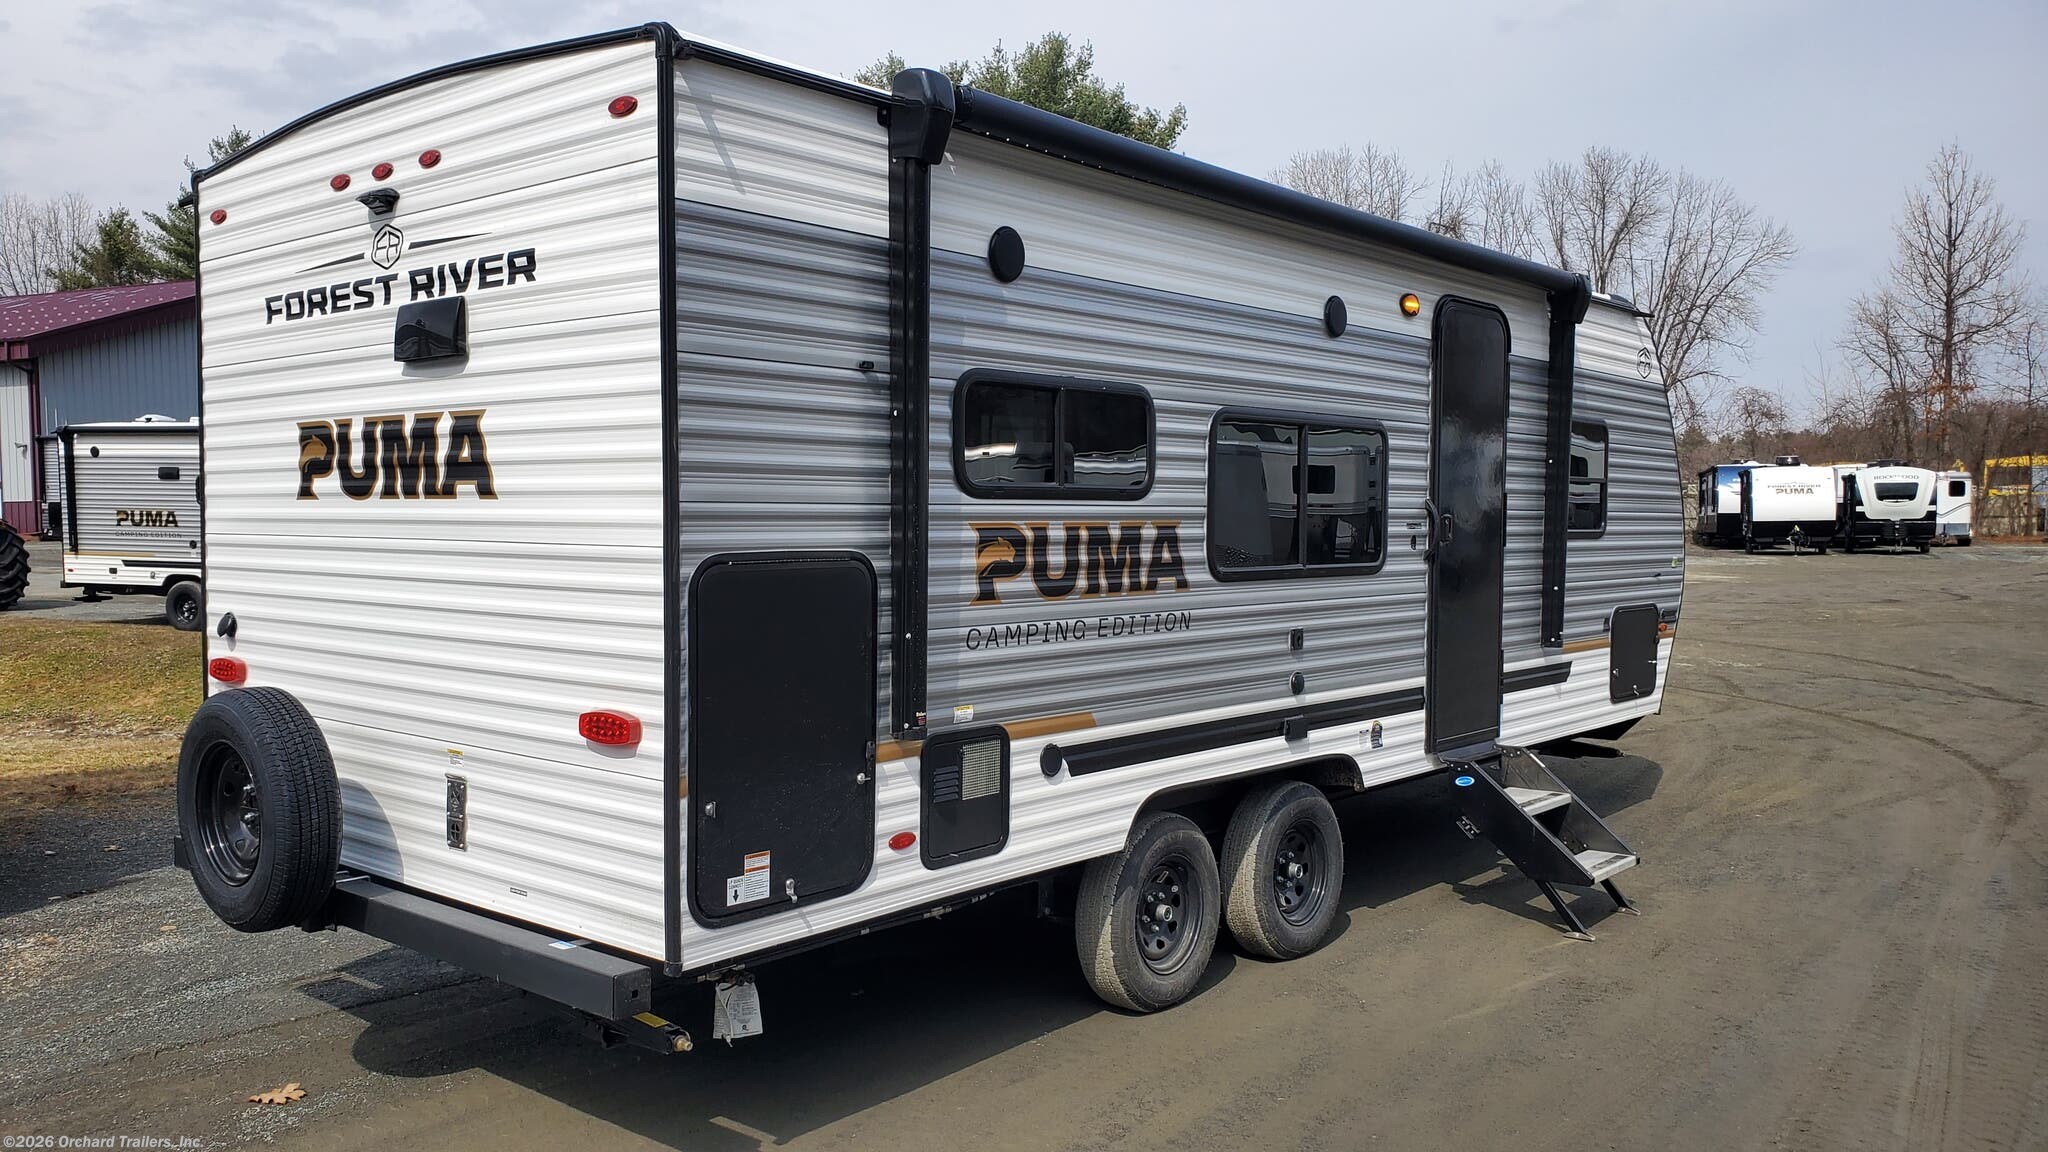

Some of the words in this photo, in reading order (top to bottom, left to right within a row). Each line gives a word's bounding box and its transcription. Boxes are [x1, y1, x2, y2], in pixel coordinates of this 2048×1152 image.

[264, 273, 399, 325] FOREST
[408, 248, 537, 302] RIVER
[296, 409, 499, 501] PUMA
[115, 510, 179, 527] PUMA
[1775, 488, 1815, 496] PUMA
[968, 520, 1190, 607] PUMA
[965, 619, 1087, 651] CAMPING
[1097, 610, 1192, 639] EDITION
